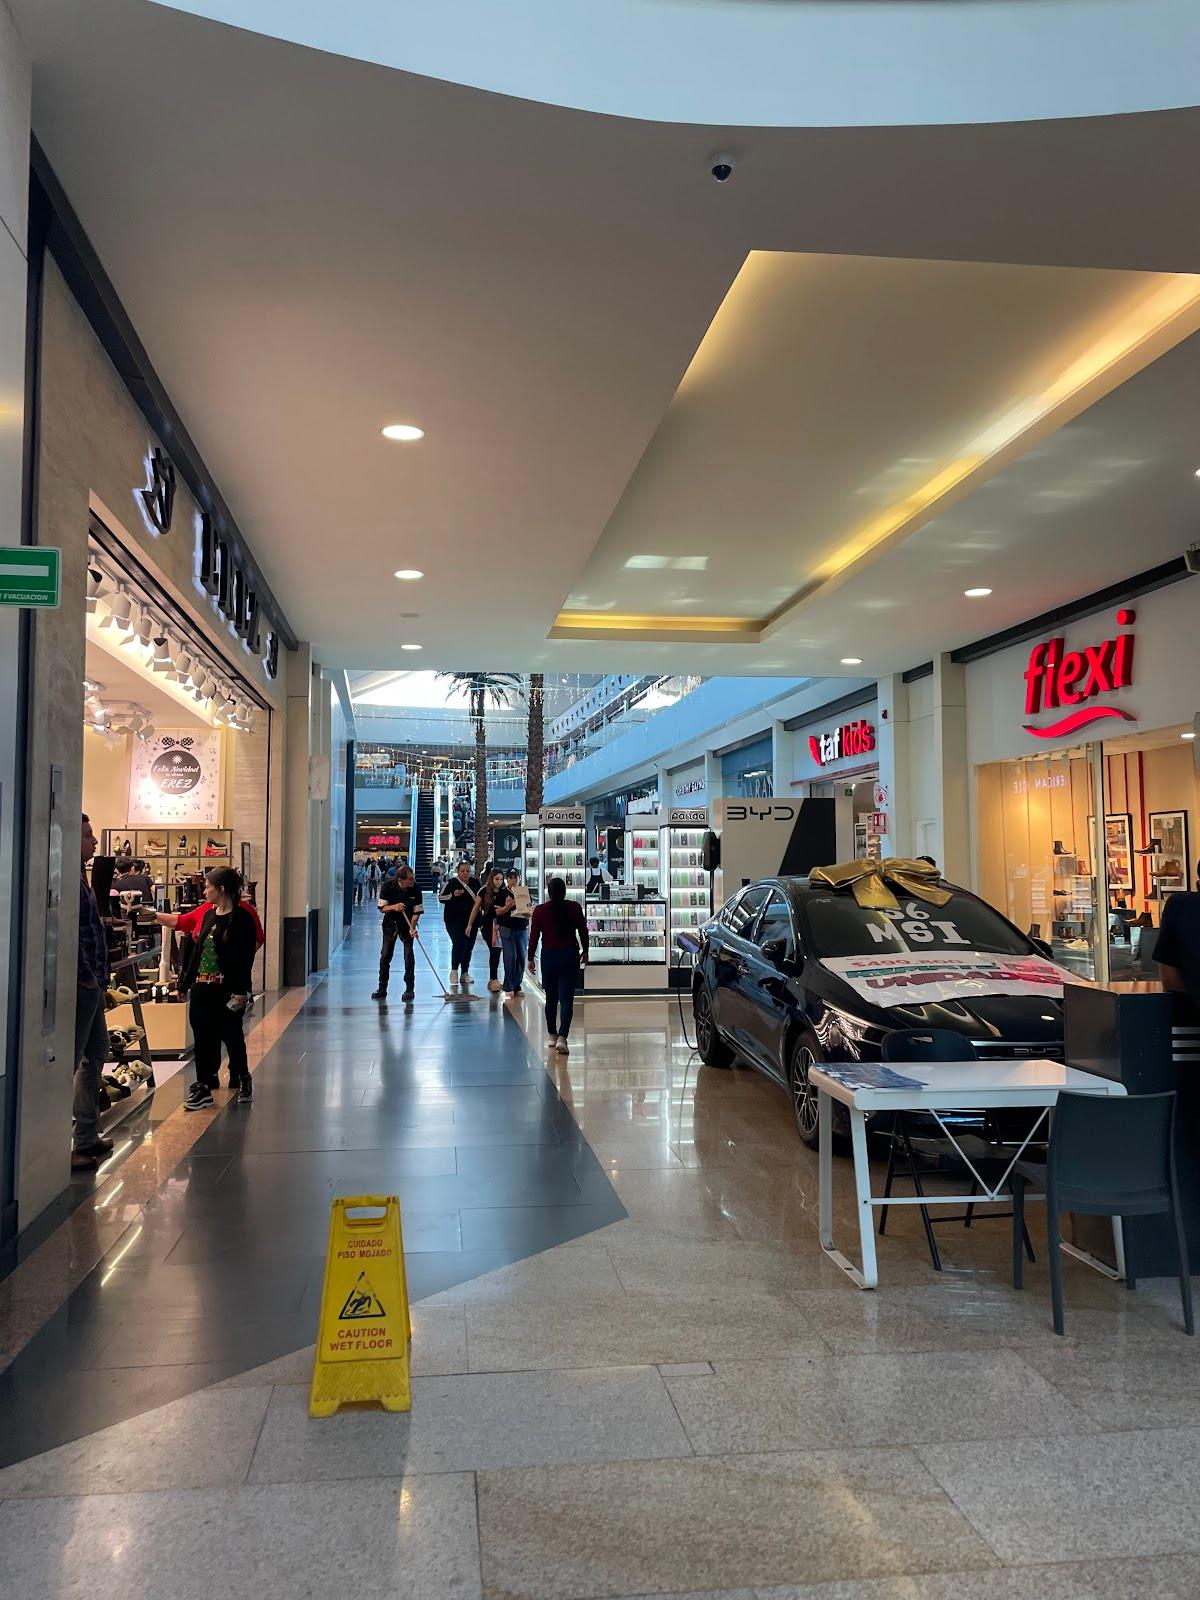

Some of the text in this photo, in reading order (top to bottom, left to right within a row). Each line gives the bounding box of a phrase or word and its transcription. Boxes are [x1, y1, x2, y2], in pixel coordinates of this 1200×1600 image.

[3, 593, 49, 601] EVACUACION
[1023, 608, 1136, 715] flexi
[819, 719, 875, 763] taf kids
[547, 811, 582, 820] panda
[671, 812, 705, 821] panda
[727, 806, 795, 821] BYD
[865, 920, 972, 945] MSI
[1013, 1047, 1062, 1057] BYD
[347, 1239, 383, 1249] CUIDADO
[337, 1248, 392, 1259] PISO MOJADO
[337, 1327, 386, 1339] CAUTION
[330, 1338, 392, 1351] WET FLOOR
